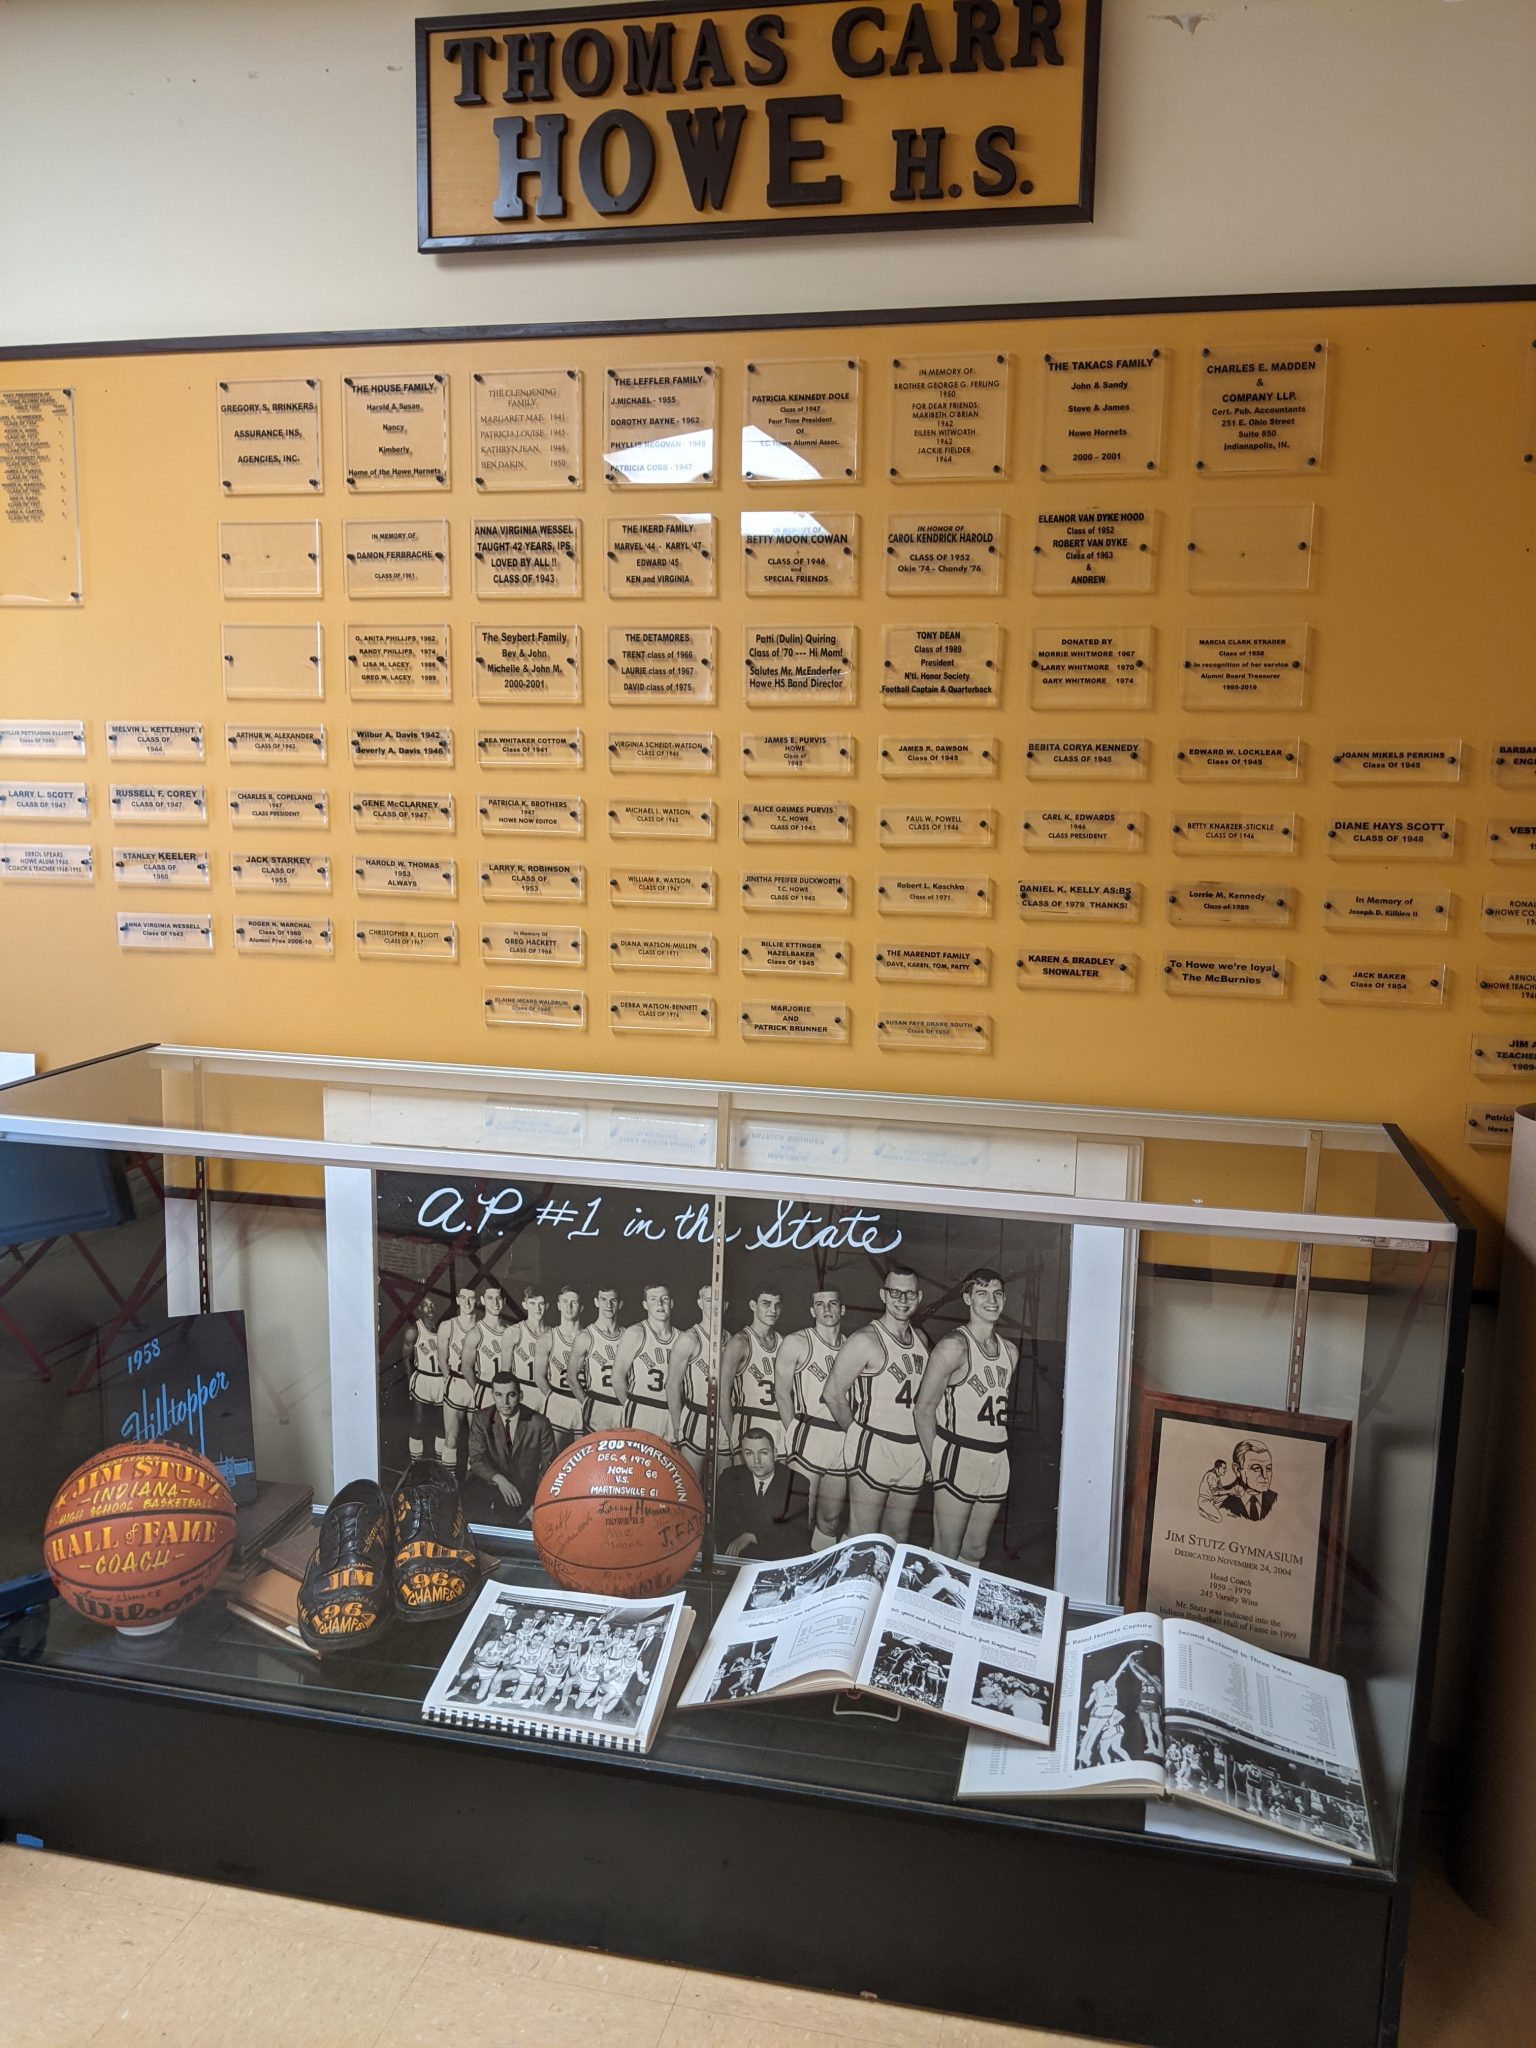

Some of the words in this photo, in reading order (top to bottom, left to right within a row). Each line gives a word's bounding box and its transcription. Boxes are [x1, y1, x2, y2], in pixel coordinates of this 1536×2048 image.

[444, 15, 789, 106] THOMAS
[832, 0, 1064, 78] CARR
[493, 94, 844, 221] HOWE
[890, 126, 1034, 200] H.S.
[1049, 362, 1068, 371] THE
[1072, 360, 1114, 370] TAKACS
[1117, 359, 1154, 368] FAMILY
[1207, 363, 1255, 374] CHARLES
[1258, 362, 1268, 372] E.
[1271, 362, 1316, 371] MADDEN
[615, 378, 630, 386] THE
[633, 377, 671, 385] LEFFLER
[674, 376, 703, 384] FAMILY
[352, 384, 368, 392] THE
[371, 384, 401, 392] HOUSE
[403, 383, 434, 392] FAMILY
[1222, 393, 1273, 402] COMPANY
[221, 403, 259, 413] GREGORY
[272, 402, 313, 412] BRINKERS
[234, 429, 283, 438] ASSURANCE
[475, 526, 497, 536] ANNA
[500, 526, 538, 535] VIRGINIA
[540, 525, 573, 534] WESSEL
[622, 525, 637, 533] THE
[639, 524, 663, 532] IKERD
[666, 524, 693, 532] FAMILY
[747, 535, 773, 544] BETTY
[776, 535, 808, 544] MOON
[811, 534, 848, 543] COWAN
[1053, 539, 1084, 548] ROBERT
[1088, 539, 1103, 547] VAN
[1106, 538, 1127, 547] DYKE
[477, 542, 510, 551] TAUGHT
[513, 542, 522, 551] 42
[525, 542, 555, 551] YEARS,
[558, 541, 570, 549] IPS
[491, 558, 519, 567] LOVED
[521, 558, 531, 567] BY
[534, 558, 549, 566] ALL
[493, 574, 520, 583] CLASS
[522, 575, 533, 583] OF
[536, 574, 554, 582] 1943
[482, 632, 498, 642] The
[501, 632, 534, 645] Seybert
[537, 632, 567, 644] Family
[626, 634, 641, 642] THE
[643, 634, 689, 642] DETAMORES
[1096, 744, 1139, 752] KENNEDY
[8, 790, 33, 798] LARRY
[47, 791, 73, 799] SCOTT
[116, 789, 155, 798] RUSSELL
[167, 790, 197, 799] COREY
[1335, 822, 1369, 830] DIANE
[1373, 822, 1403, 831] HAYS
[1406, 822, 1444, 832] SCOTT
[246, 856, 268, 864] JACK
[271, 856, 310, 865] STARKEY
[1028, 955, 1059, 964] KAREN
[1062, 956, 1069, 964] &
[1072, 956, 1115, 966] BRADLEY
[1043, 968, 1099, 977] SHOWALTER
[1170, 960, 1182, 968] To
[1185, 961, 1214, 969] Howe
[1218, 962, 1247, 971] we're
[1250, 962, 1275, 974] loyal
[1182, 973, 1202, 982] The
[1205, 974, 1261, 984] McBurnies
[536, 1197, 601, 1240] #1
[623, 1205, 666, 1240] in
[667, 1203, 741, 1243] th
[745, 1199, 904, 1254] State
[127, 1338, 160, 1374] 1958
[121, 1371, 229, 1456] Hilltopper
[977, 1396, 1009, 1426] 42
[631, 1456, 651, 1467] 1976
[550, 1471, 567, 1497] JIM
[563, 1445, 593, 1473] STUTZ
[641, 1445, 681, 1482] VARSITY
[676, 1481, 687, 1502] WIN
[607, 1466, 633, 1475] HOWE
[72, 1463, 122, 1498] JIM
[134, 1460, 224, 1499] STUTZ
[591, 1485, 645, 1496] MARTINSVILLE
[91, 1501, 133, 1517] SCHOOL
[143, 1497, 212, 1509] BASKETBALL
[52, 1526, 119, 1563] HALL
[126, 1523, 138, 1544] of
[143, 1520, 217, 1544] FAME
[396, 1541, 476, 1568] STUTZ
[1273, 1567, 1292, 1576] 2004
[321, 1570, 375, 1592] JIM
[401, 1572, 465, 1598] 1966
[1210, 1573, 1228, 1583] Head
[1230, 1576, 1252, 1587] Coach
[1210, 1582, 1226, 1591] 1959
[1235, 1587, 1252, 1596] 1979
[408, 1586, 455, 1606] CHAMPS
[1200, 1589, 1213, 1598] 245
[1215, 1592, 1238, 1604] Varsity
[1241, 1597, 1258, 1607] Wins
[75, 1585, 204, 1621] Wilson
[1176, 1601, 1187, 1609] Mr.
[1189, 1602, 1206, 1612] Stutz
[1209, 1607, 1222, 1616] was
[1224, 1608, 1253, 1622] inducted
[1255, 1616, 1268, 1625] into
[1270, 1618, 1281, 1627] the
[319, 1616, 368, 1635] CHAMPS
[1159, 1606, 1185, 1618] Indiana
[1186, 1611, 1221, 1625] Basketball
[1223, 1619, 1237, 1630] Hall
[1239, 1622, 1248, 1630] of
[1250, 1624, 1268, 1635] Fame
[1280, 1630, 1297, 1640] 1999
[1178, 1629, 1205, 1642] Second
[1206, 1635, 1239, 1655] Sectional
[1249, 1654, 1271, 1668] Three
[1272, 1663, 1293, 1676] Years
